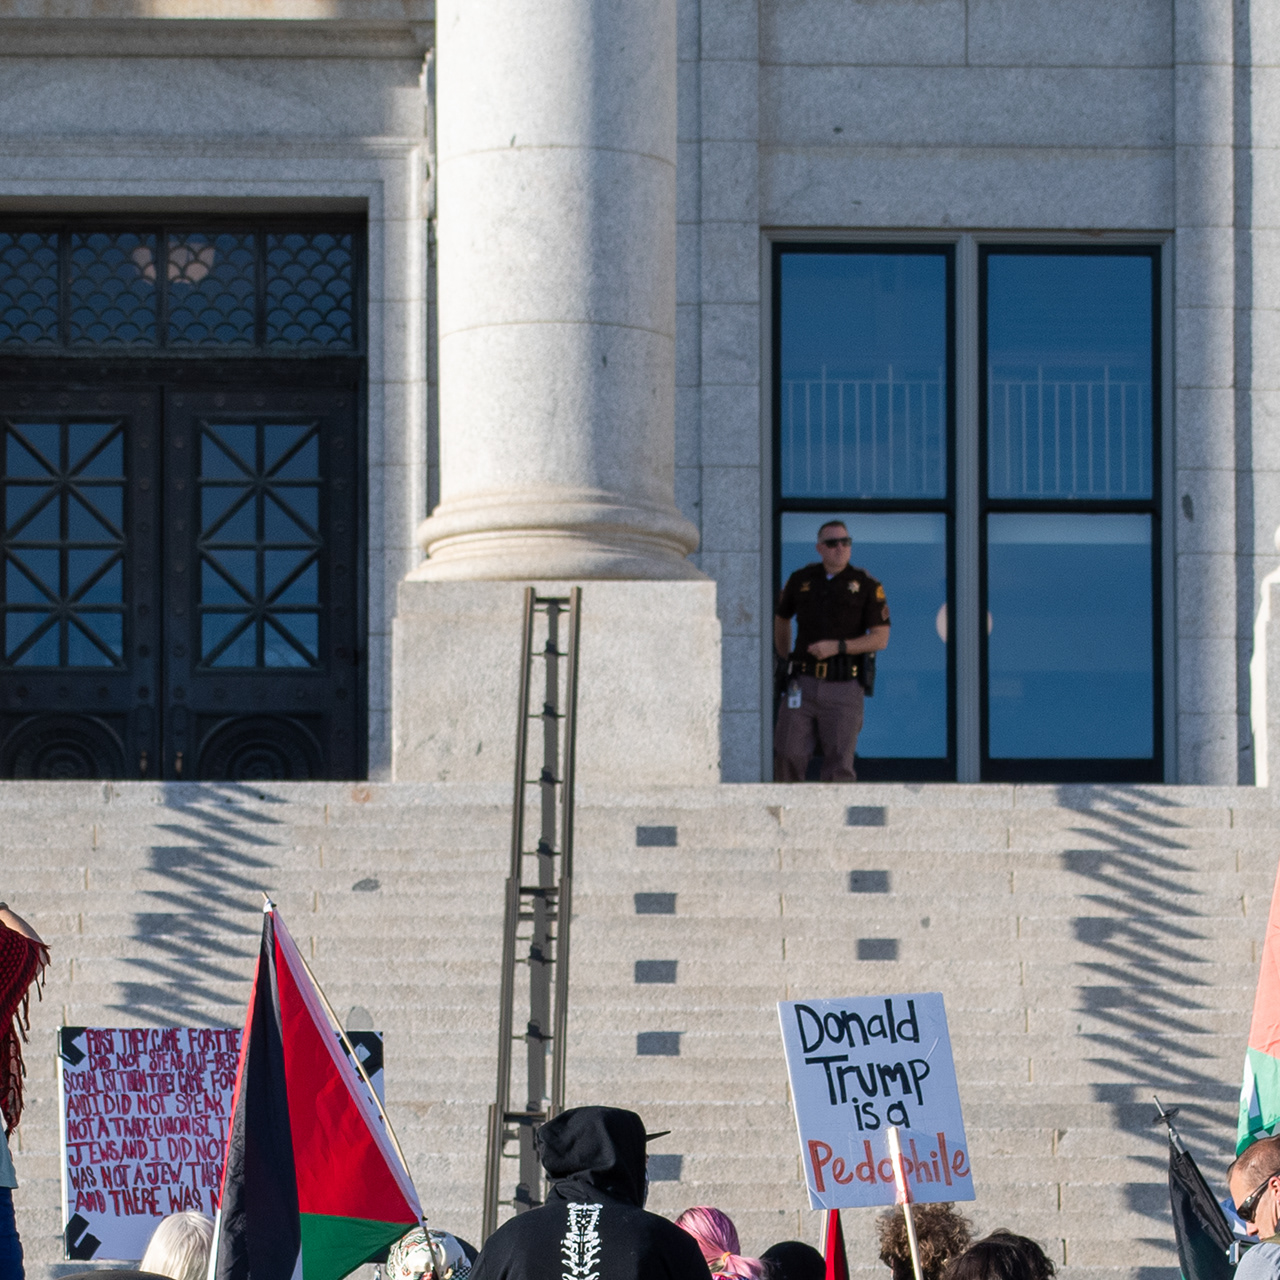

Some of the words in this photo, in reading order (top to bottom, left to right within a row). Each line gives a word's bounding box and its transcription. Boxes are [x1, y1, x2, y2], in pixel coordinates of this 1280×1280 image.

[794, 998, 920, 1054] Donald
[86, 1029, 117, 1055] FIRST
[120, 1029, 150, 1055] THEY
[151, 1027, 182, 1053] CAME
[88, 1052, 111, 1071] DID
[117, 1052, 141, 1069] NOT
[178, 1069, 207, 1094] CAME
[211, 1069, 237, 1093] FOR
[805, 1054, 931, 1106] Trump
[67, 1094, 92, 1118] AND
[103, 1094, 132, 1115] DID
[137, 1093, 171, 1115] NOT
[176, 1089, 226, 1115] SPEAK
[852, 1097, 881, 1131] is
[886, 1100, 911, 1129] a
[67, 1116, 95, 1142] NOT
[97, 1116, 110, 1139] A
[120, 1139, 149, 1162] AND
[150, 1138, 164, 1161] I
[167, 1136, 193, 1162] DID
[195, 1138, 229, 1163] NOT
[68, 1166, 98, 1190] WAS
[101, 1165, 131, 1190] NOT
[134, 1163, 146, 1186] A
[186, 1161, 224, 1189] THEN
[108, 1186, 164, 1217] THERE
[168, 1186, 204, 1214] WAS
